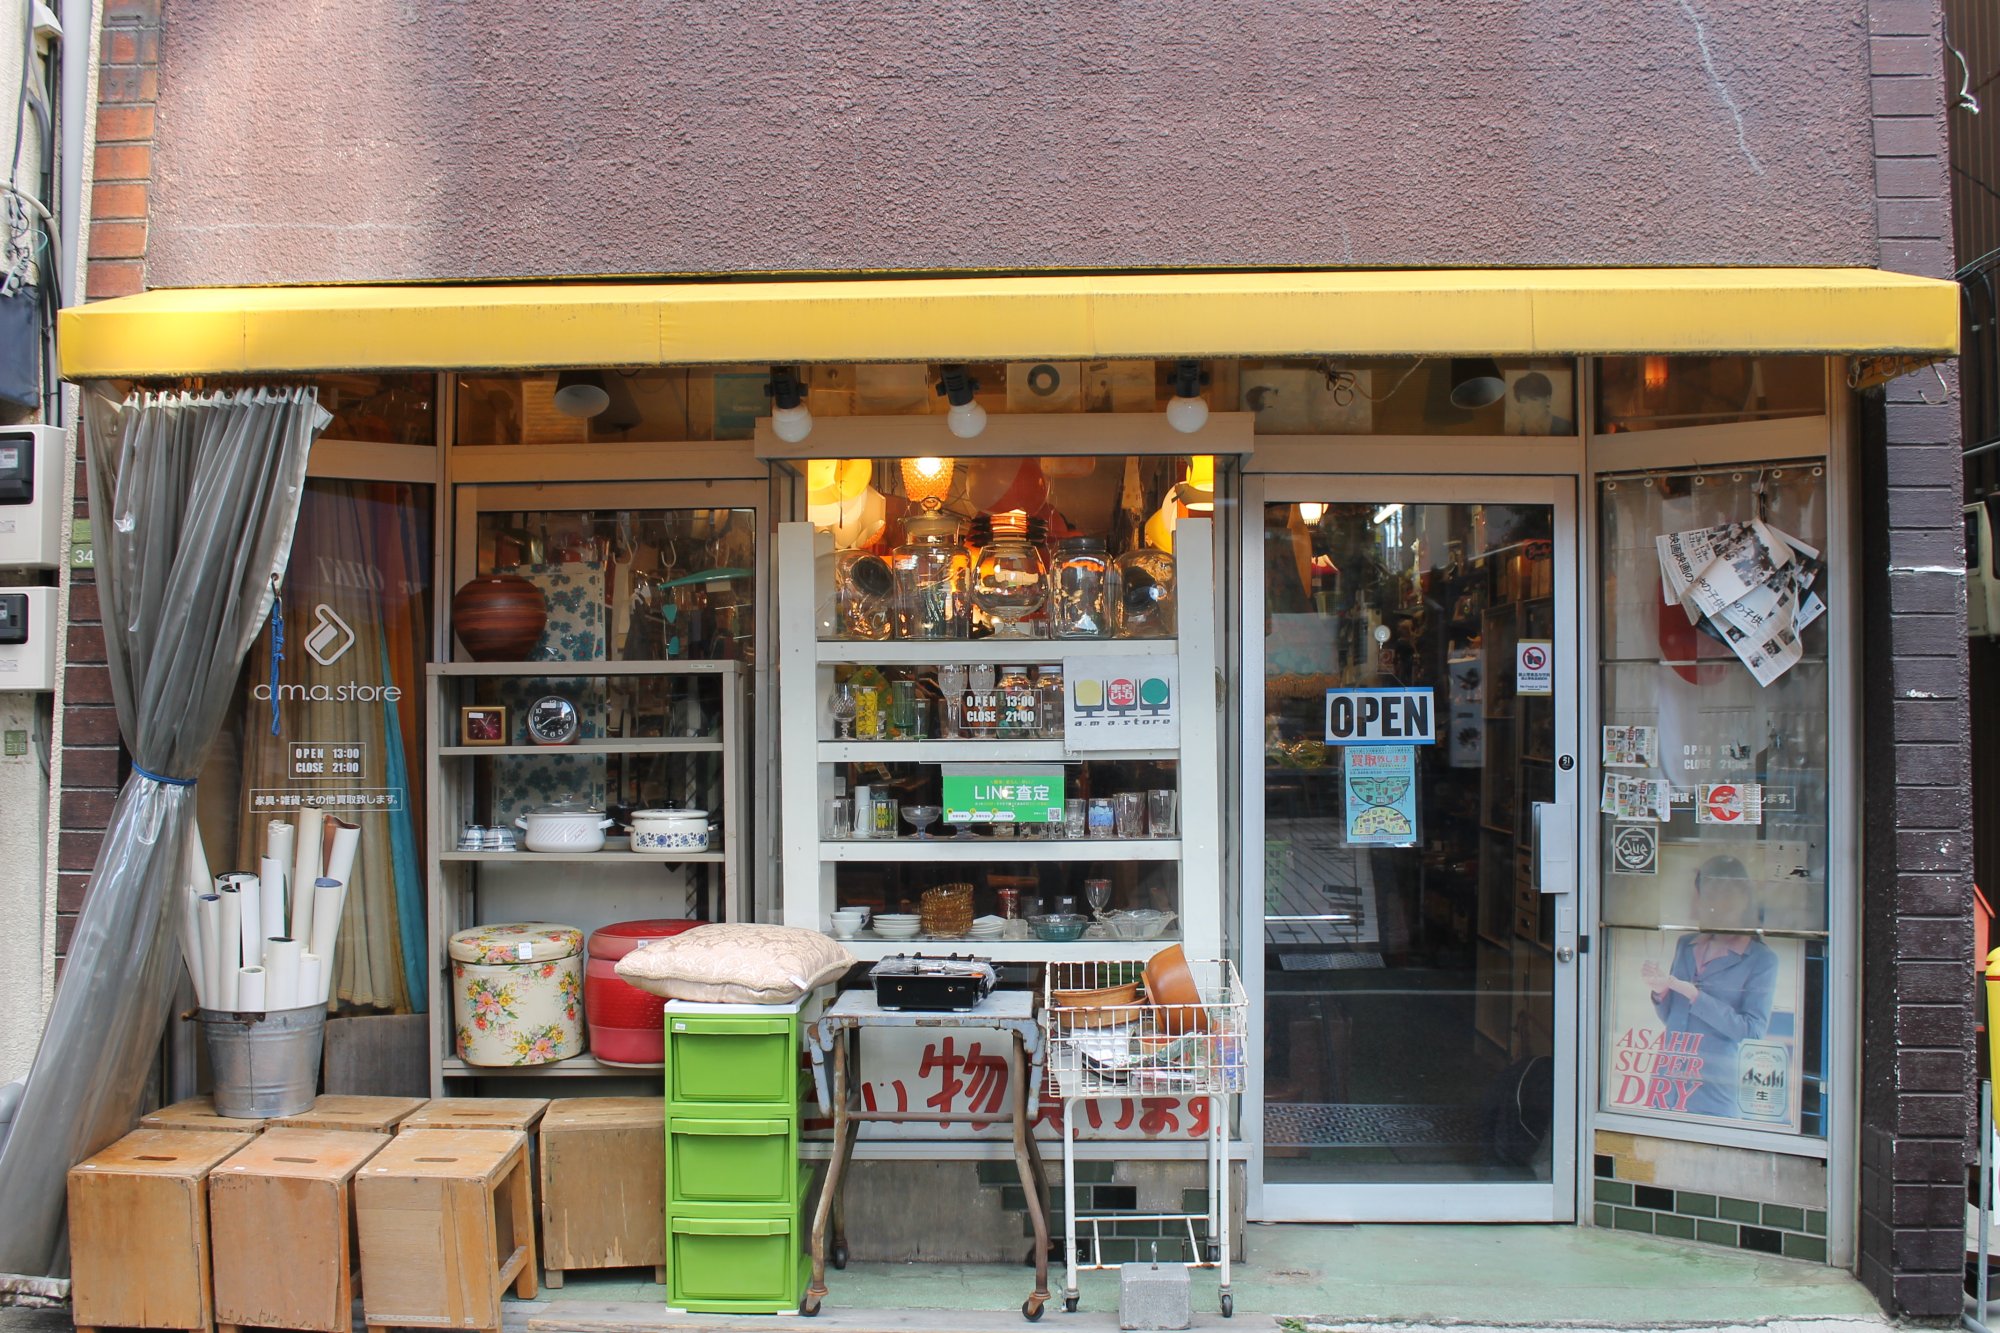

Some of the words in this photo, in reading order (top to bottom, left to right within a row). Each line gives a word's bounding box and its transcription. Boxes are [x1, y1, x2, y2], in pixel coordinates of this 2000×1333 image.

[75, 549, 94, 563] 34
[254, 681, 401, 702] am.a.store
[967, 696, 996, 707] OPEN
[1006, 696, 1035, 707] 13:00
[967, 711, 996, 722] CLOSE
[1006, 711, 1035, 722] 21:00
[1330, 696, 1429, 738] OPEN
[295, 748, 324, 759] OPEN
[332, 748, 360, 759] 13:00
[295, 762, 324, 773] CLOSE
[332, 762, 359, 773] 21:00
[974, 784, 1050, 801] LINE査定
[1616, 1027, 1704, 1055] ASAHI
[1615, 1050, 1704, 1078] SUPER
[1742, 1067, 1785, 1089] Asahi
[1615, 1074, 1704, 1112] DRY
[1756, 1091, 1769, 1101] 生
